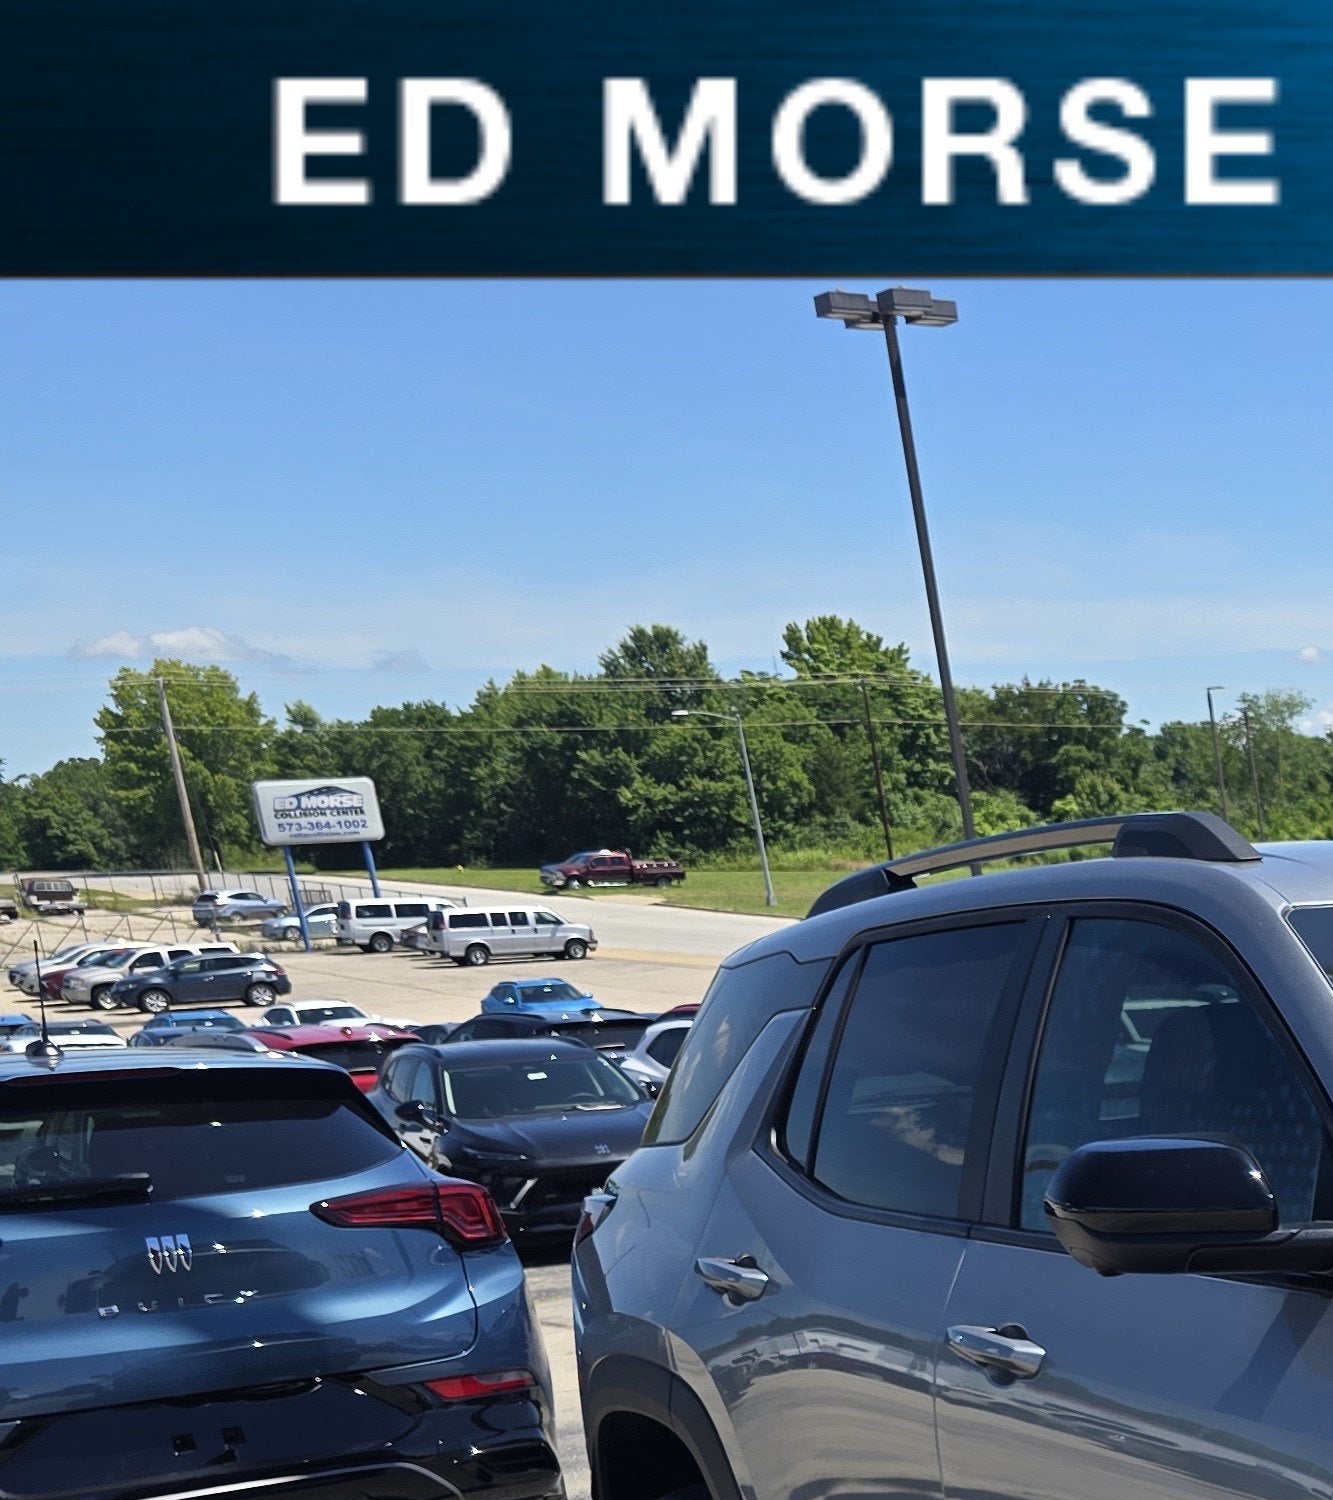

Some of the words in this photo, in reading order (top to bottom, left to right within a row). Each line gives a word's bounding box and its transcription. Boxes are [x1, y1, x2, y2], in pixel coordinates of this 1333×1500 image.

[274, 797, 298, 810] ED
[300, 794, 364, 809] MORSE
[274, 809, 327, 819] COLLISION
[330, 807, 366, 817] CENTER
